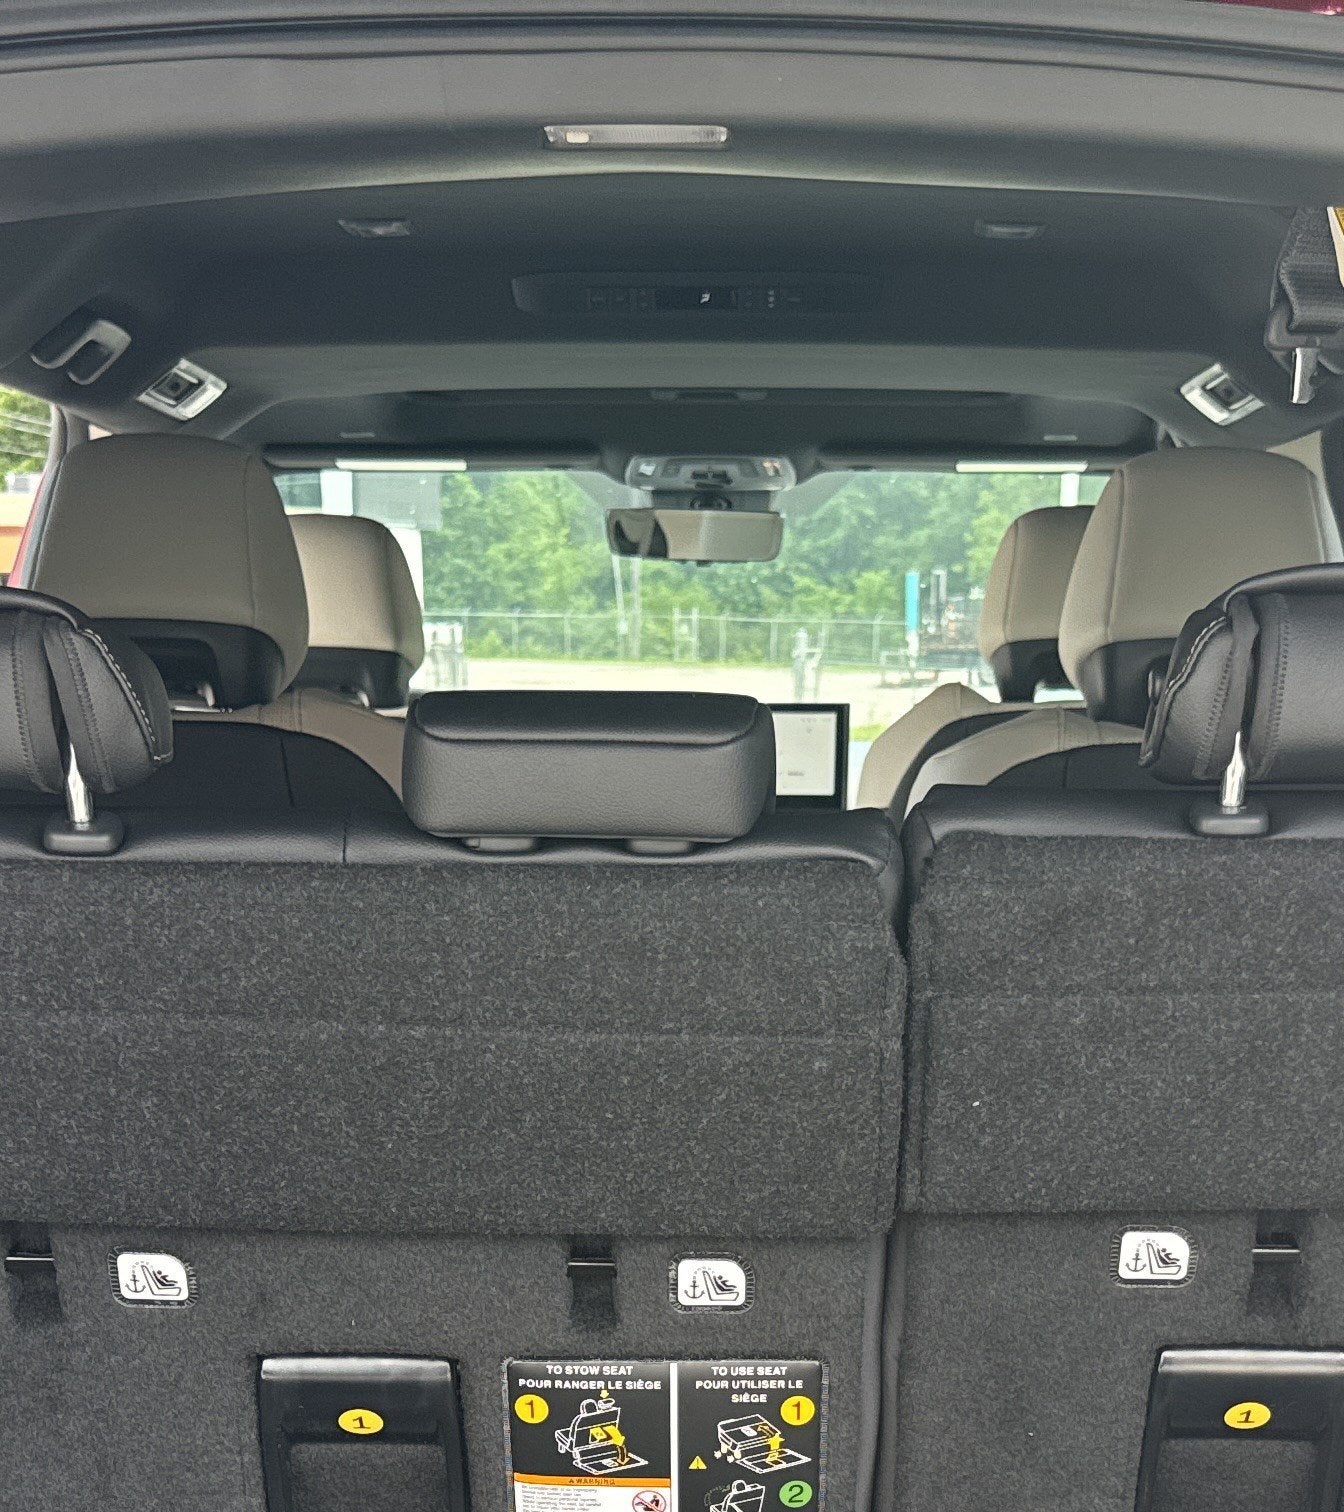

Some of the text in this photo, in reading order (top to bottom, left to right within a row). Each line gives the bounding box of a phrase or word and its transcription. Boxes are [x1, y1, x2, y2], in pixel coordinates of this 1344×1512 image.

[545, 1365, 634, 1376] TO STOW SEAT
[711, 1366, 788, 1376] TO USE SEAT
[518, 1379, 552, 1389] POUR
[554, 1379, 605, 1390] RANGER
[607, 1380, 623, 1389] LE
[695, 1380, 804, 1390] POUR UTILISER LE
[524, 1399, 535, 1419] 1
[792, 1400, 801, 1421] 1
[352, 1415, 372, 1429] 1
[1236, 1409, 1255, 1424] 1
[788, 1484, 804, 1503] 2
